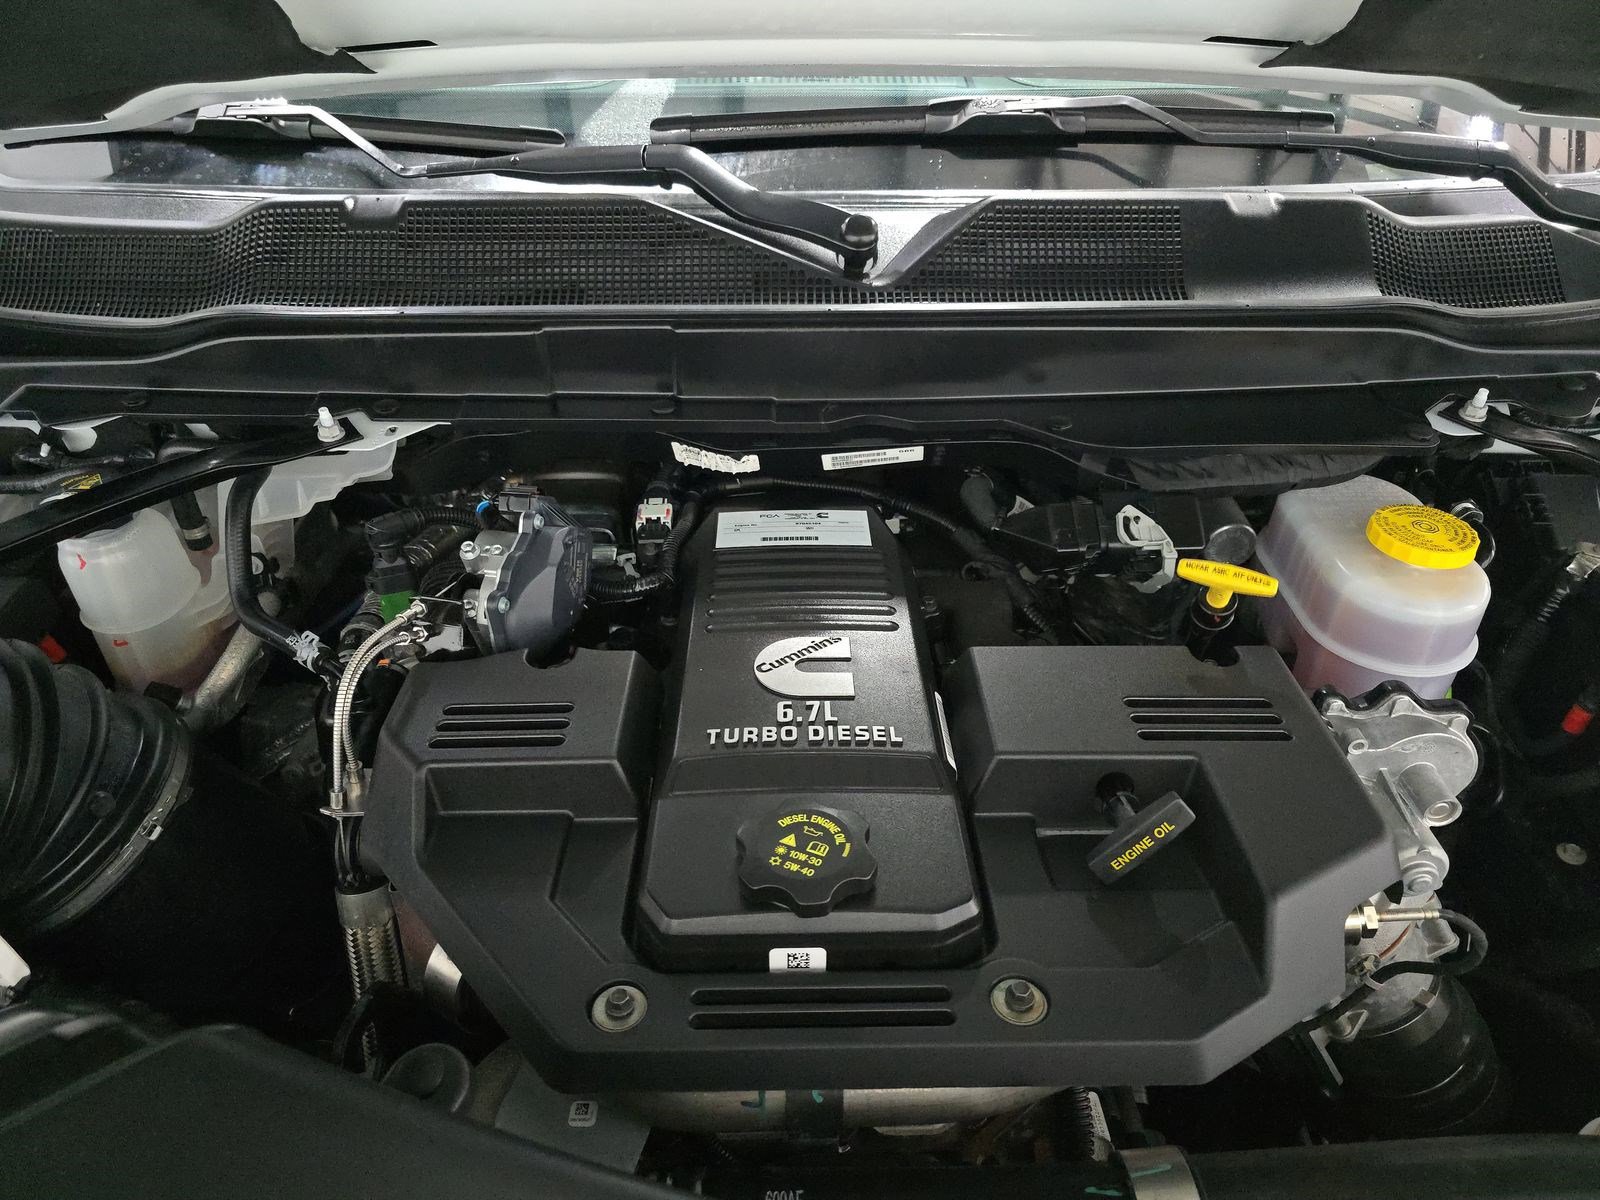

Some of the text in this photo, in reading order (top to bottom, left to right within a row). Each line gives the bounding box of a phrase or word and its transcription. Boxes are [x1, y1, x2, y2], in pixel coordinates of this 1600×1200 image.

[1185, 561, 1209, 573] MOPAR
[756, 637, 842, 673] Cummins
[776, 700, 838, 723] 6.7L
[706, 725, 904, 745] TURBO DIESEL
[777, 814, 847, 846] DIESEL ENGINE OIL
[1110, 822, 1176, 871] ENGINE OIL
[789, 850, 823, 866] 10W-30
[783, 861, 815, 877] 5W-40
